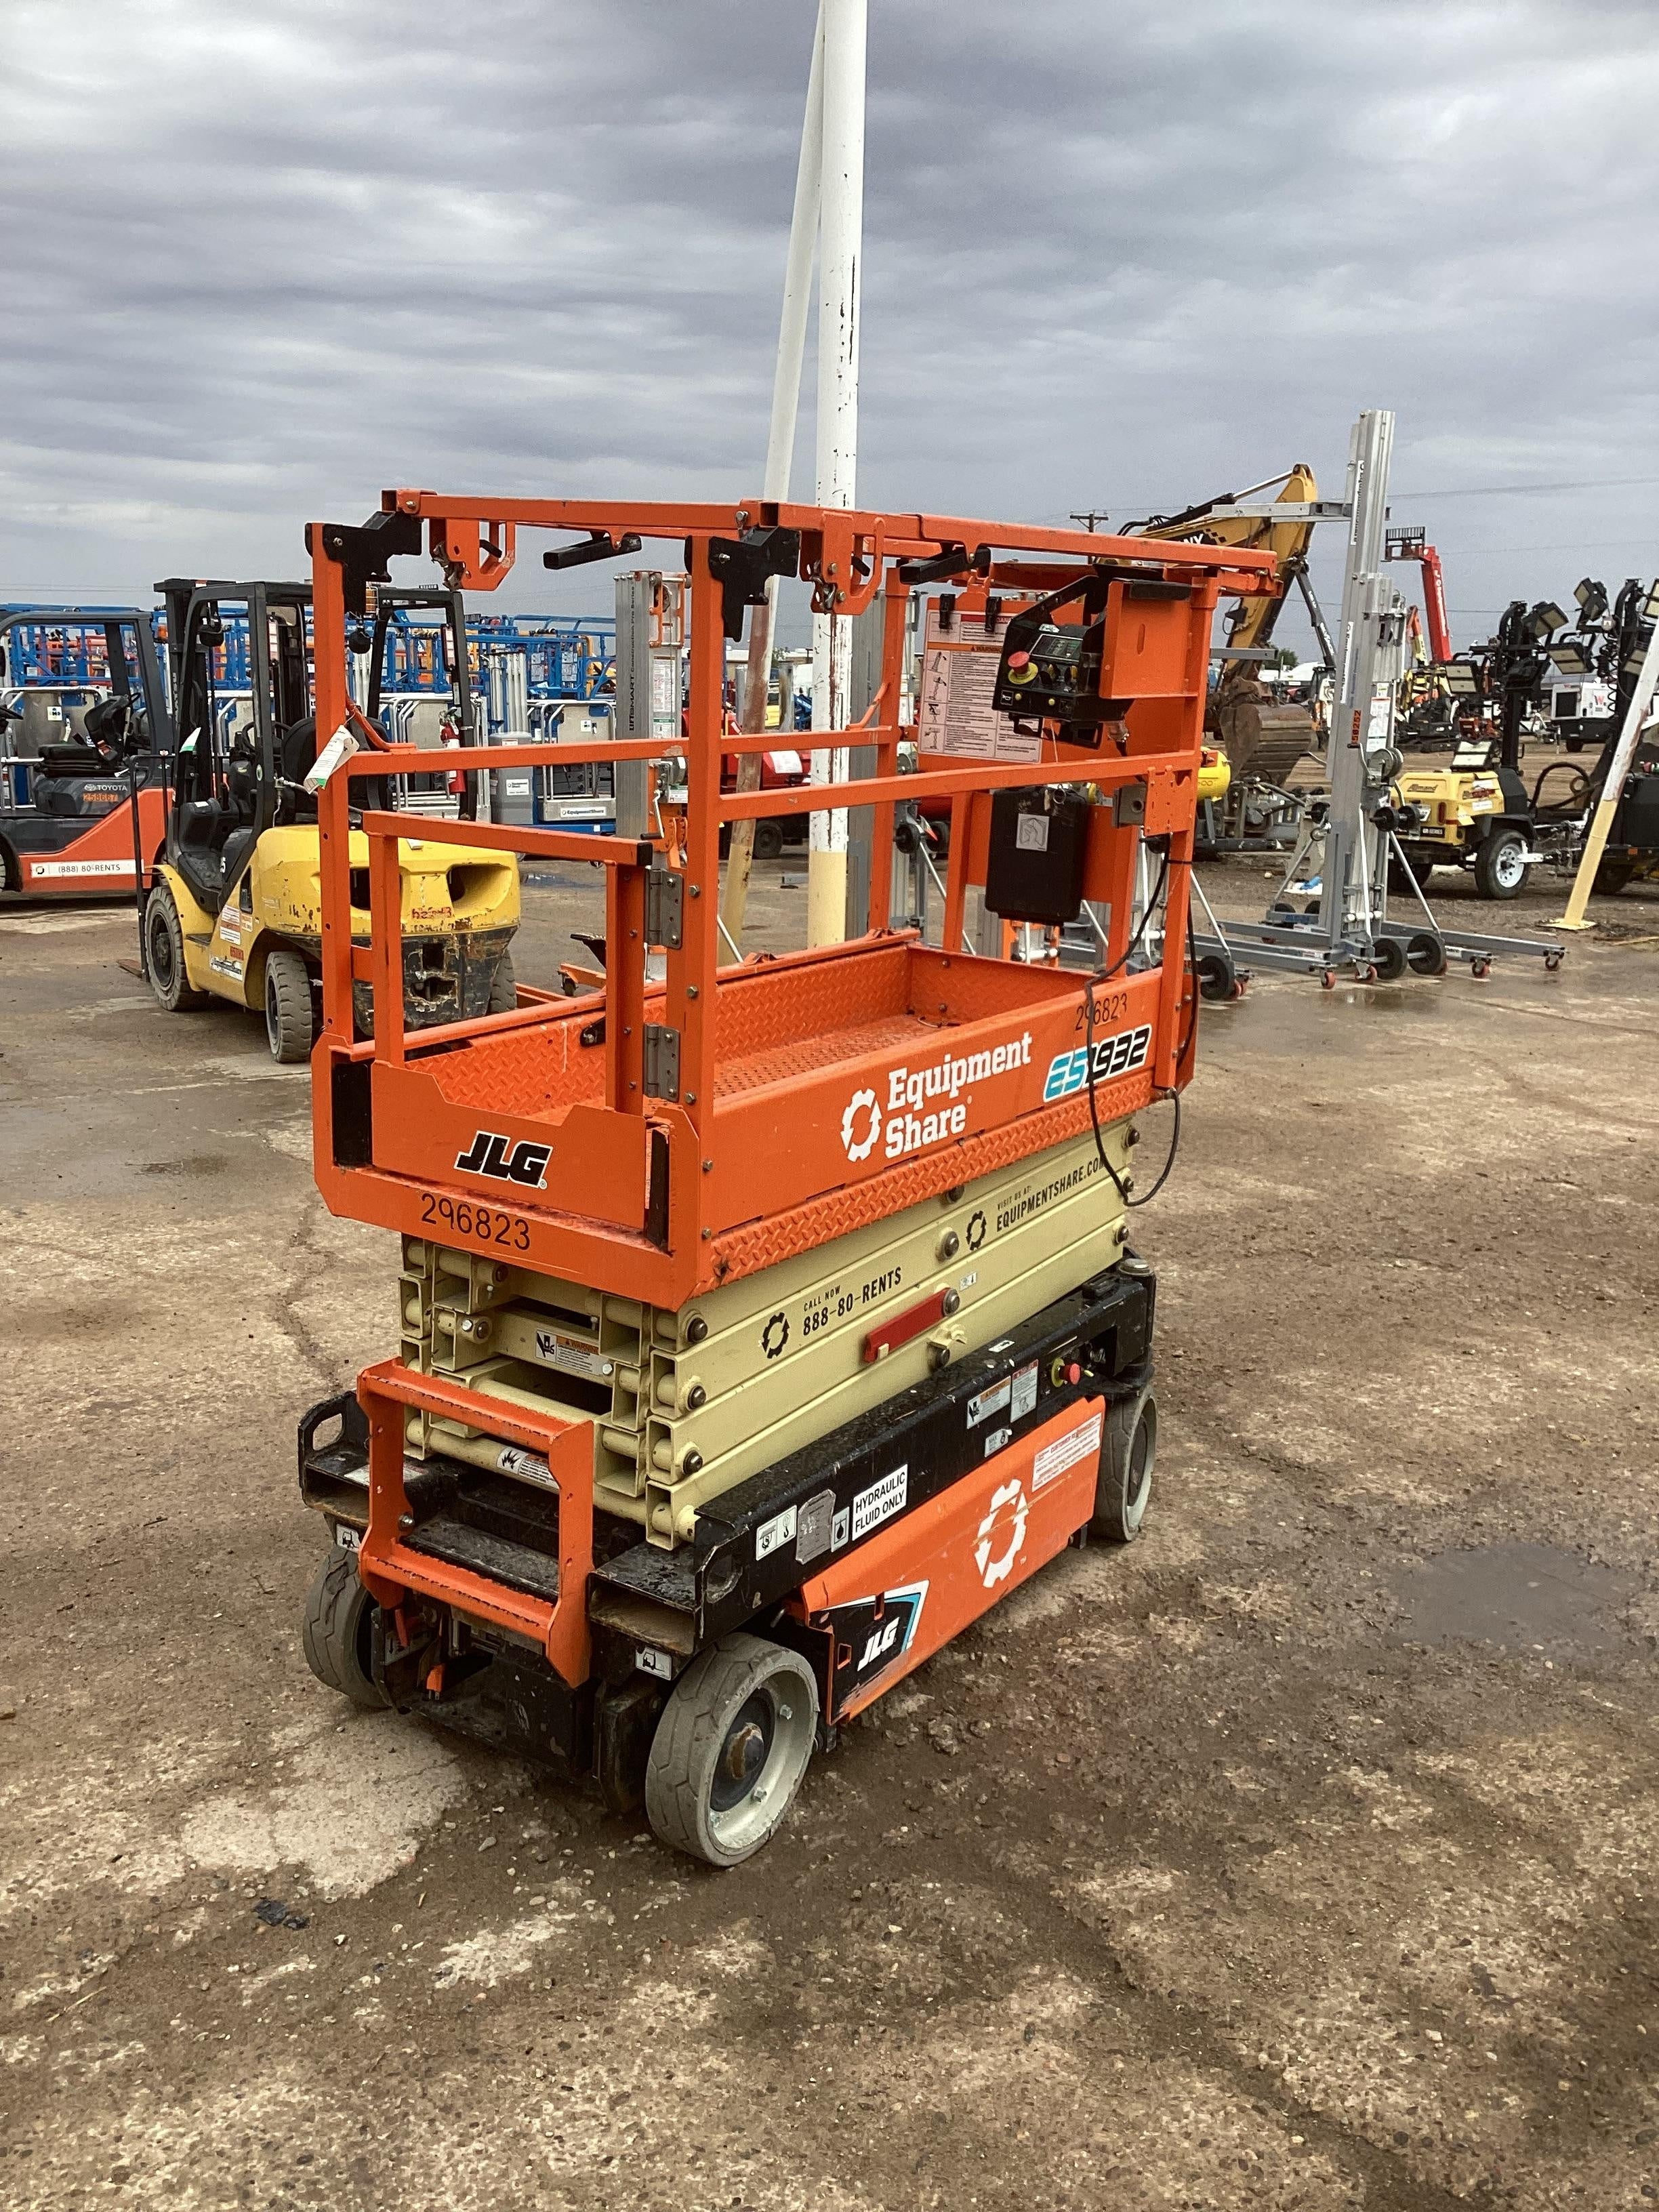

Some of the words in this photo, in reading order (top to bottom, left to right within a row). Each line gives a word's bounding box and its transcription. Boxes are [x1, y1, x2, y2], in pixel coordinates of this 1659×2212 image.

[58, 865, 79, 874] (888)
[888, 1032, 1032, 1110] Equipment
[885, 1105, 966, 1158] Share
[455, 1131, 553, 1188] JLG
[420, 1193, 531, 1251] 296823
[1015, 1191, 1022, 1200] US
[802, 1266, 902, 1336] 888-80-RENTS
[803, 1295, 821, 1312] CALL
[824, 1285, 841, 1301] NOW
[855, 1471, 905, 1514] HYDRAULIC
[855, 1507, 880, 1534] FLUID
[882, 1489, 905, 1515] ONLY
[857, 1617, 900, 1671] JLG
